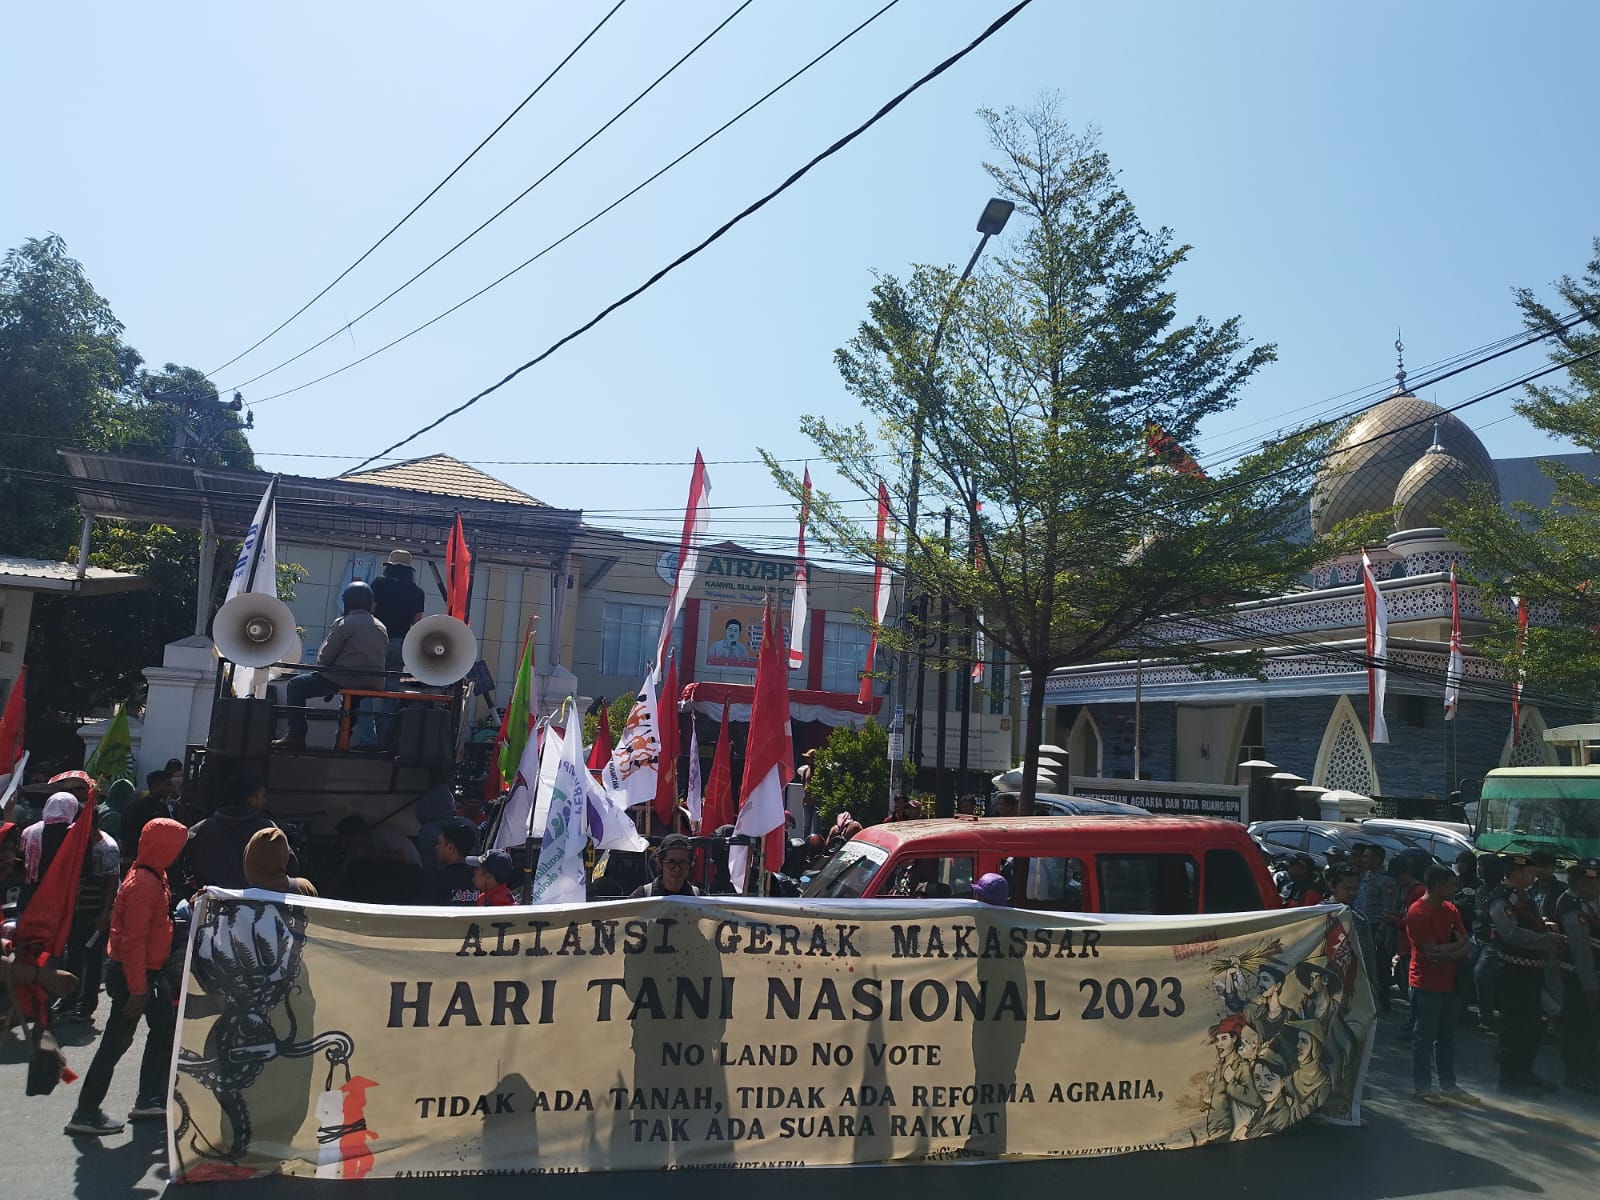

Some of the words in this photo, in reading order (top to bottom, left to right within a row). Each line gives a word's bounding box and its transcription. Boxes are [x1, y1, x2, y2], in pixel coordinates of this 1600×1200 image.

[704, 580, 735, 590] KANWIL
[1131, 794, 1162, 809] AGRARIA
[1165, 797, 1180, 809] DAN
[1183, 799, 1200, 810] TATA
[456, 918, 678, 957] ALIANSI
[715, 919, 862, 958] GERAK
[890, 924, 1101, 959] MAKASSAR
[387, 979, 557, 1028] HARI
[586, 976, 735, 1023] TANI
[765, 976, 1062, 1022] NASIONAL
[1079, 976, 1186, 1021] 2023
[661, 1041, 705, 1067] NO
[719, 1042, 798, 1067] LAND
[811, 1042, 854, 1067] NO
[867, 1043, 942, 1067] VOTE
[415, 1092, 516, 1119] TIDAK
[534, 1088, 595, 1113] ADA
[609, 1086, 723, 1115] TANAH,
[736, 1085, 826, 1110] TIDAK
[839, 1085, 898, 1108] ADA
[911, 1082, 1036, 1108] REFORMA
[1048, 1079, 1164, 1104] AGRARIA,
[629, 1117, 691, 1143] TAK
[705, 1117, 766, 1142] ADA
[779, 1113, 876, 1139] SUARA
[890, 1111, 1000, 1138] RAKYAT
